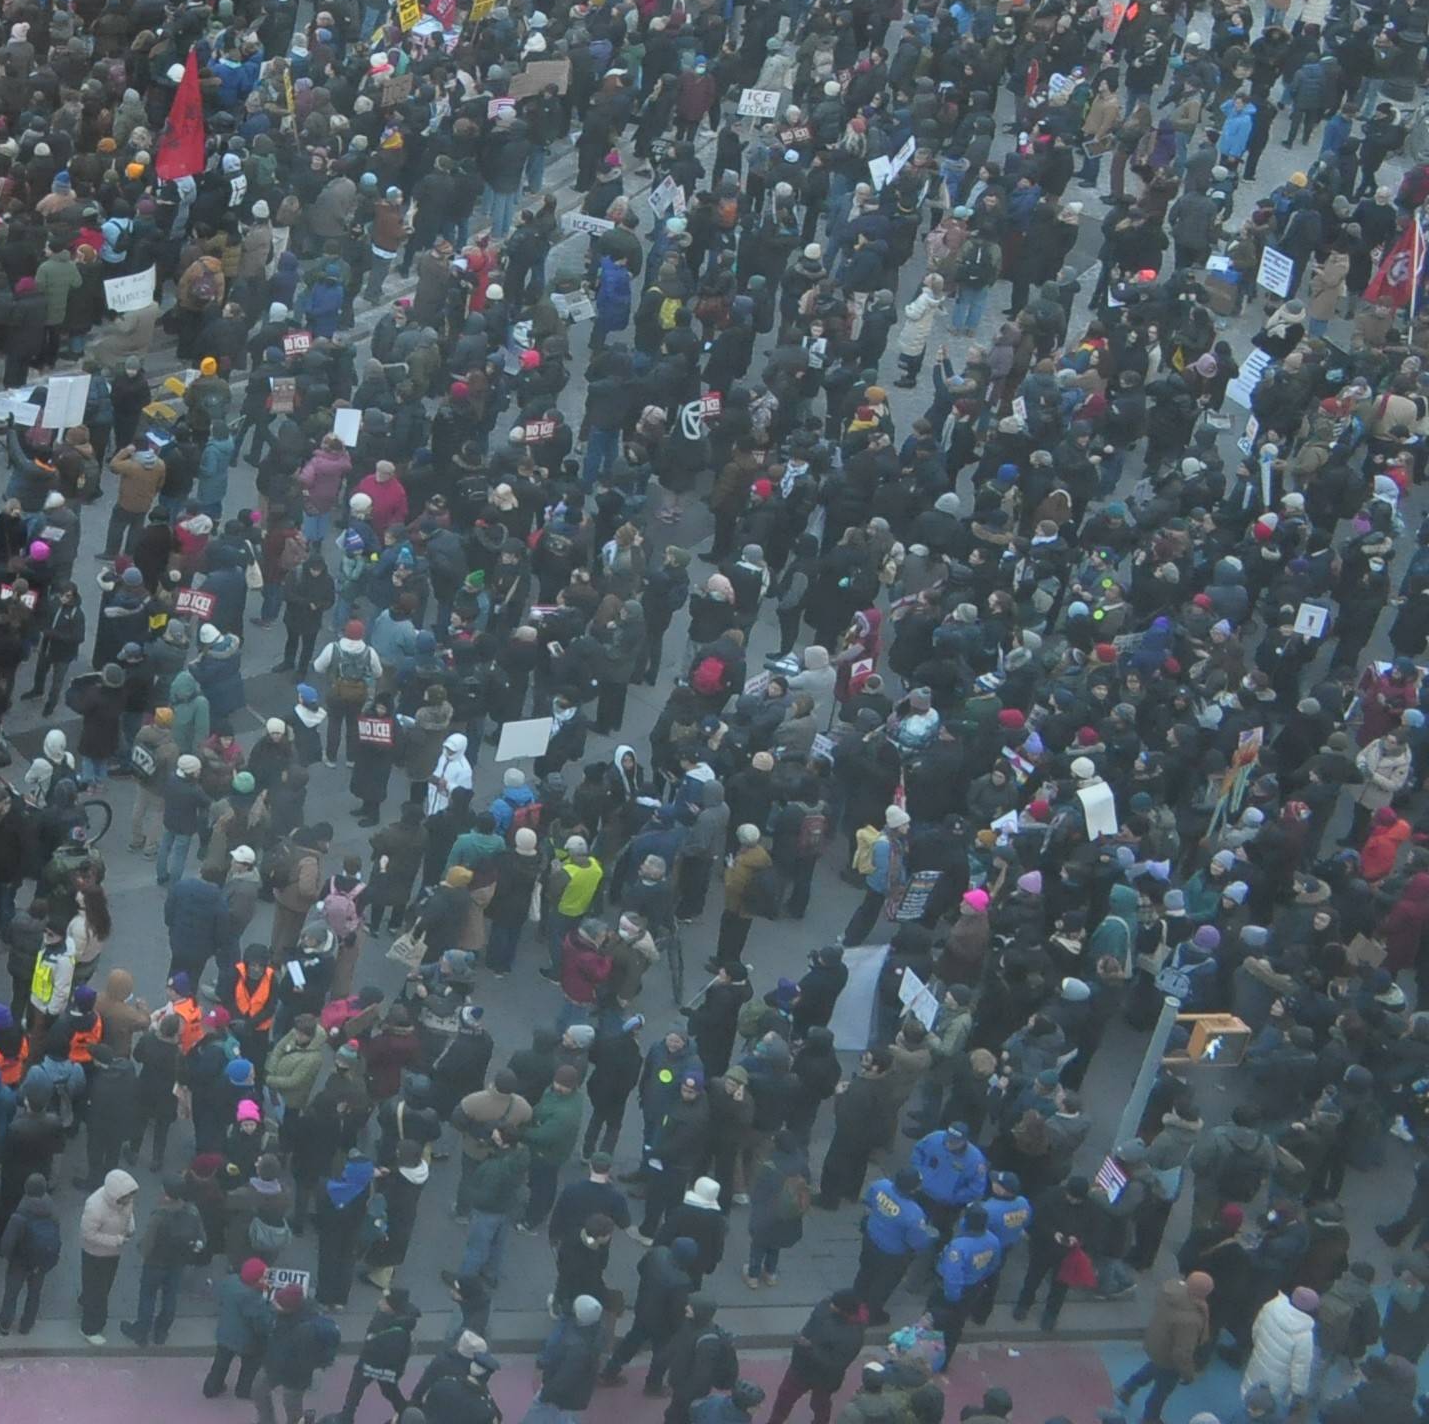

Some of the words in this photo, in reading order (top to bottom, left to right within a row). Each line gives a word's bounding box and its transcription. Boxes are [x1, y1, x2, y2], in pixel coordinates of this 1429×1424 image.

[747, 92, 773, 103] ICE
[526, 424, 539, 436] NO
[540, 423, 554, 435] ICE!
[178, 592, 191, 606] NO
[192, 595, 211, 612] ICE!
[358, 720, 372, 735] NO
[372, 722, 390, 738] ICE!
[876, 1190, 900, 1217] NYPD
[279, 1271, 308, 1284] OUT
